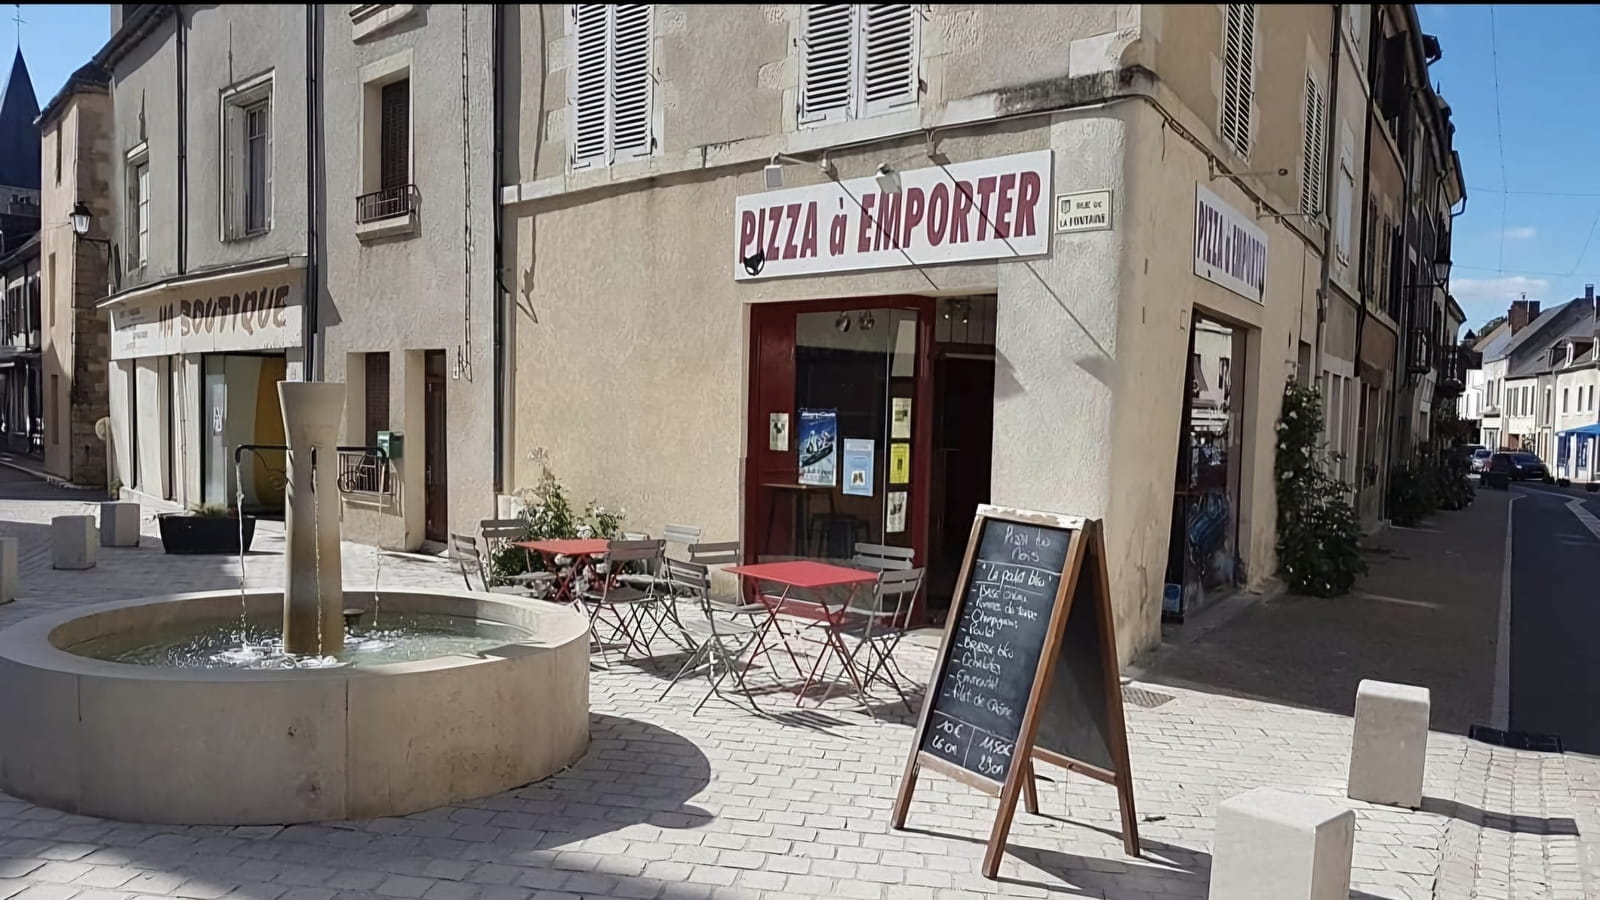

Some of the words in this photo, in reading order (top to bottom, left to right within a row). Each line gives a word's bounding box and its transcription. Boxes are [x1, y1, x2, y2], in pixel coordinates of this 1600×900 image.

[740, 200, 818, 263] PIZZA
[830, 197, 846, 256] à
[857, 170, 1041, 253] EMPORTER
[1060, 218, 1068, 227] LA
[1069, 213, 1105, 227] FONTAINE
[1076, 200, 1091, 209] RUE
[1093, 200, 1103, 208] DE
[1197, 200, 1222, 270] PIZZA
[181, 285, 290, 337] BOUTIQUE
